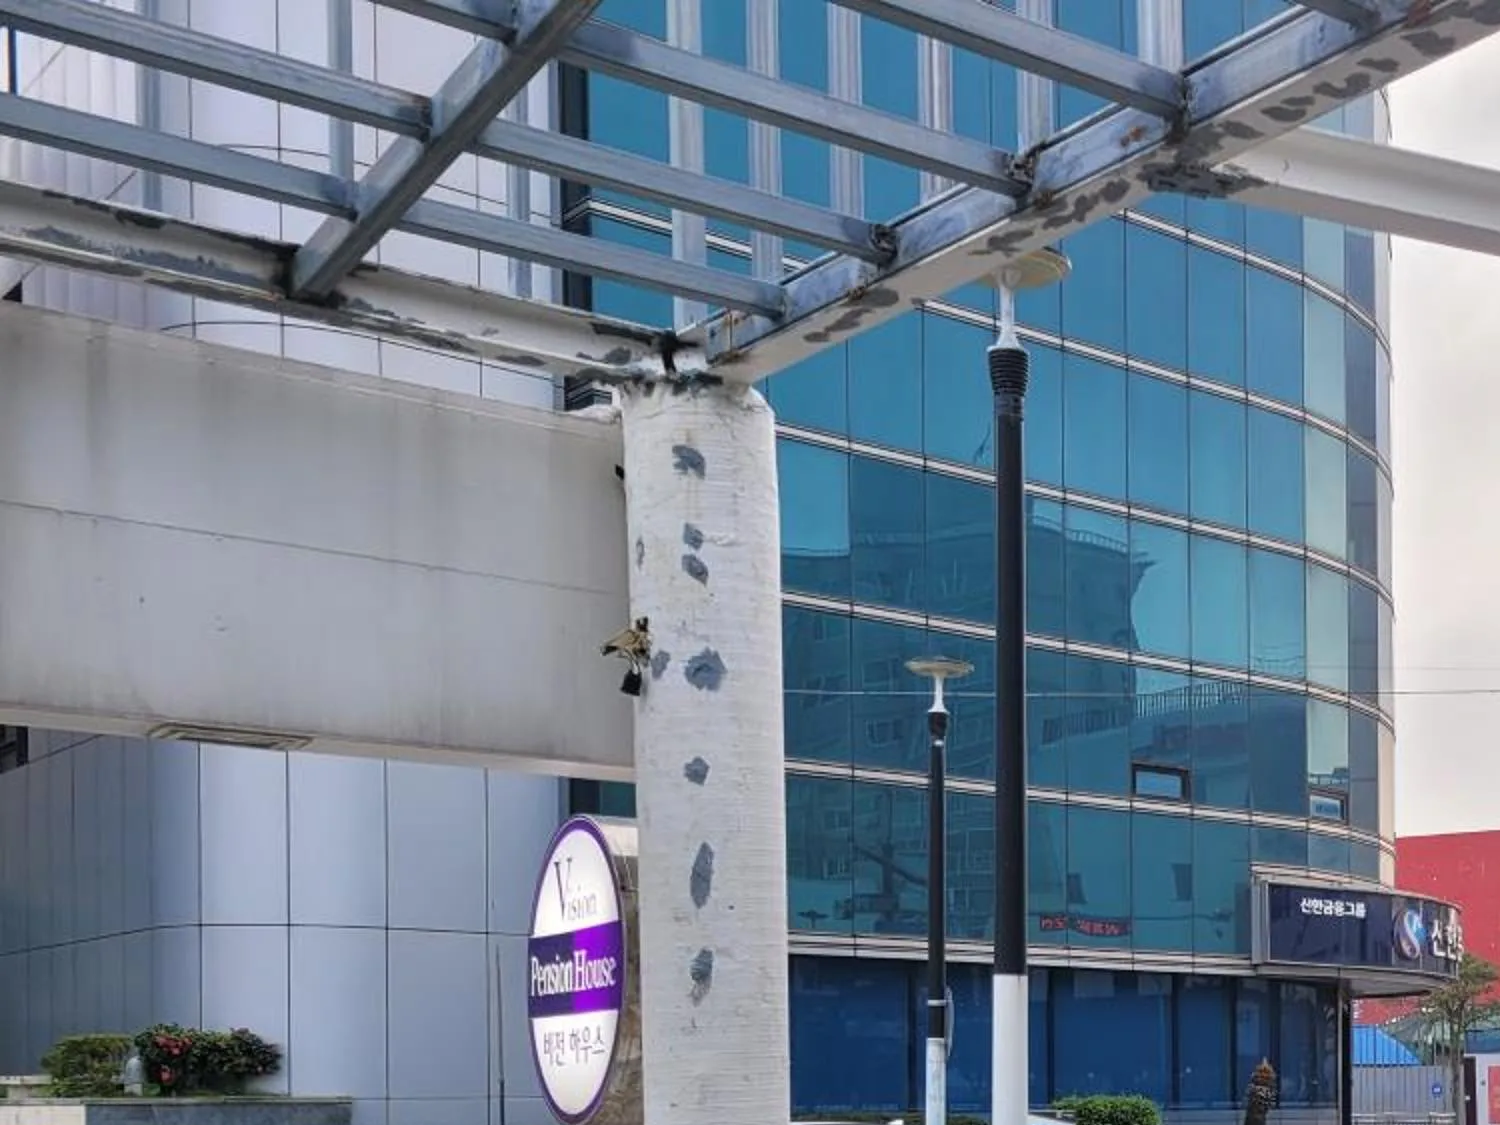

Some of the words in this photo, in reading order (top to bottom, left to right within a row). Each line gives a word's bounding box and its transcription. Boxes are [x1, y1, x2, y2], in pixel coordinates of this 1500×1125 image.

[553, 857, 597, 921] Vision
[1299, 896, 1367, 919] 신한금융그룹
[568, 1024, 606, 1065] 하우스
